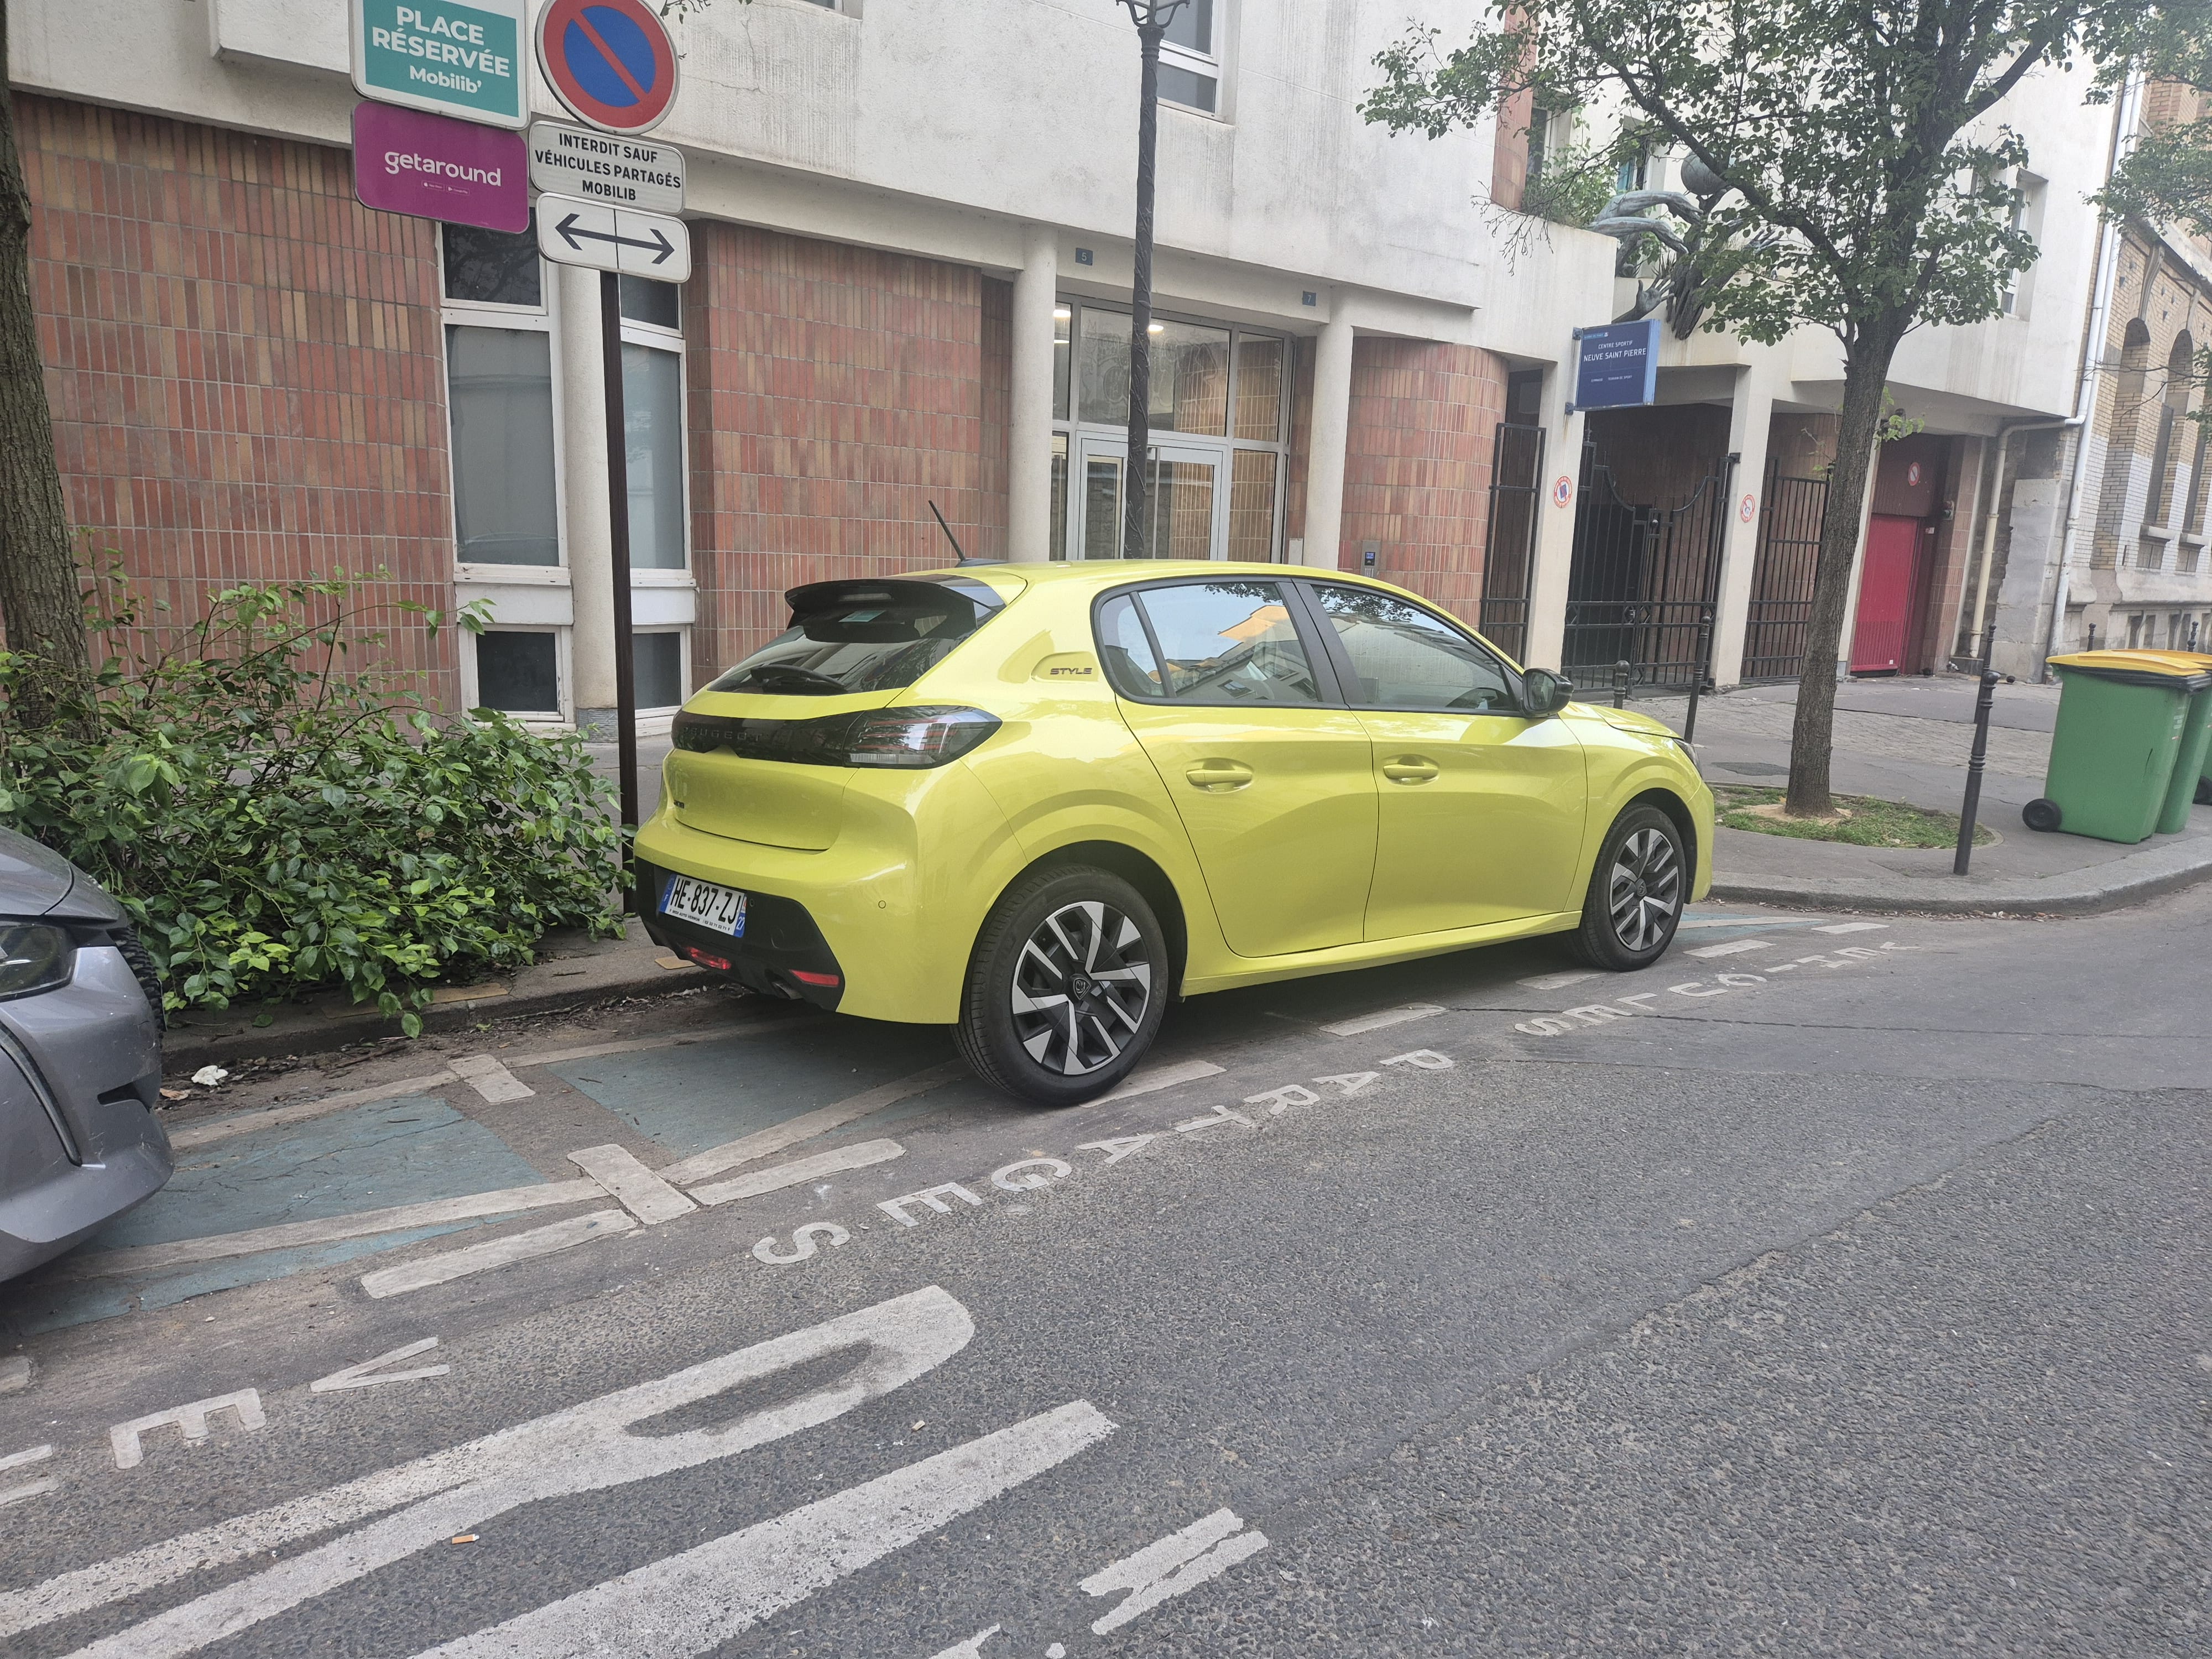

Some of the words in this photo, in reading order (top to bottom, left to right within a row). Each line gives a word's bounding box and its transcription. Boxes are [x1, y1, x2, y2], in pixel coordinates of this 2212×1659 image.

[397, 6, 484, 45] PLACE
[372, 27, 510, 77] RÉSERVÉE
[559, 133, 620, 156] INTERDIT
[623, 146, 658, 163] SAUF
[384, 151, 501, 187] getaround
[535, 149, 611, 175] VÉHICULES
[614, 165, 681, 189] PARTAGÉS
[582, 180, 636, 201] MOBILIB
[1081, 252, 1087, 261] 5
[1308, 295, 1312, 303] 7
[1583, 353, 1604, 362] NEUVE
[1605, 351, 1623, 359] SAINT
[1623, 348, 1647, 357] PIERRE
[670, 878, 742, 924] HE-837-ZJ
[736, 916, 745, 930] 27
[752, 1048, 1454, 1264] PARTAGES
